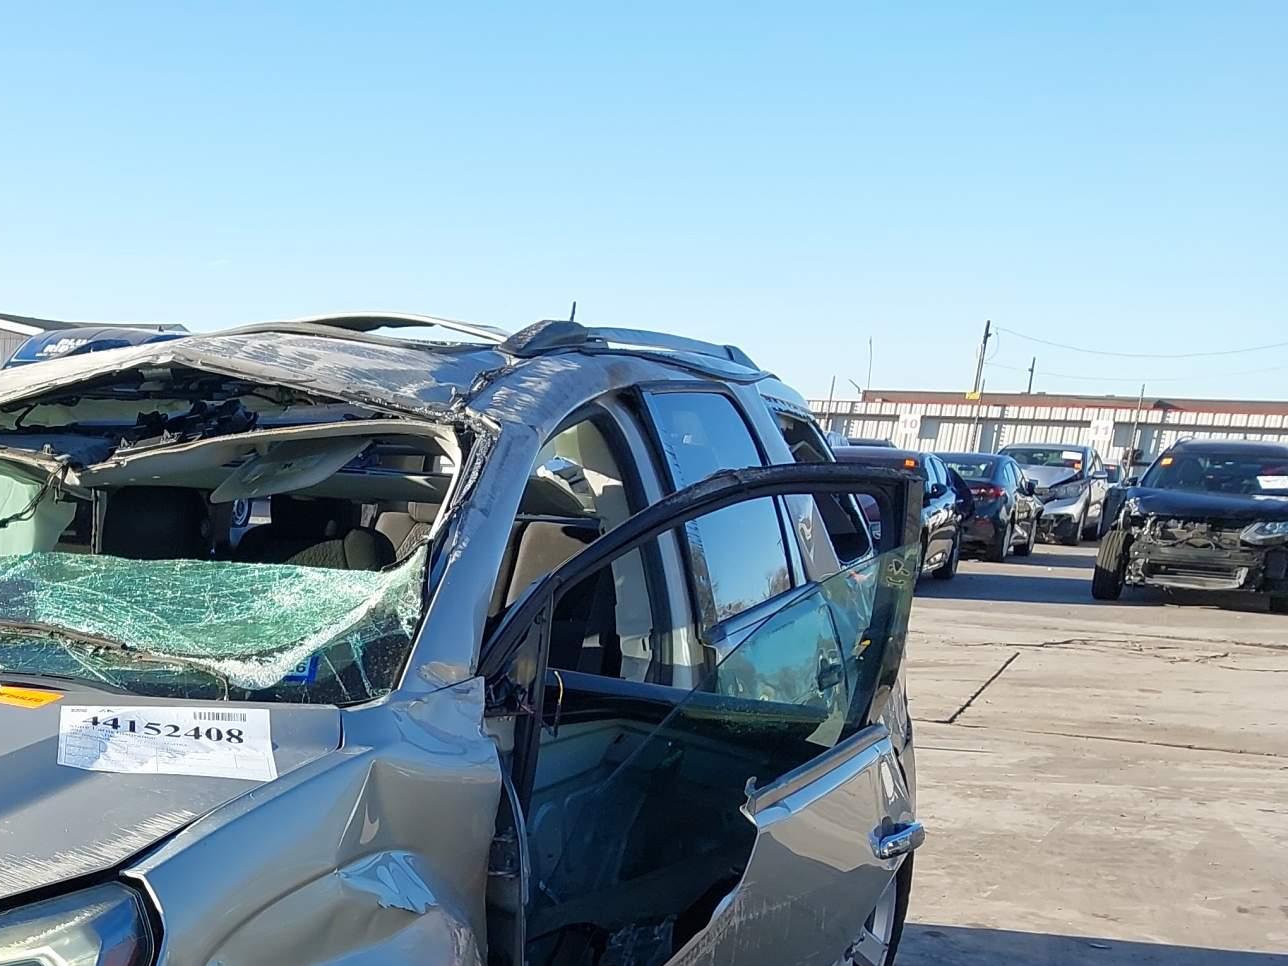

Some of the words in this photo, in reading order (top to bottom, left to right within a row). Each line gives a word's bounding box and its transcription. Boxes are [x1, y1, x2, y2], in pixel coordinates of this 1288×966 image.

[901, 418, 918, 429] 10
[1092, 425, 1109, 436] 11
[82, 715, 245, 744] 44152408
